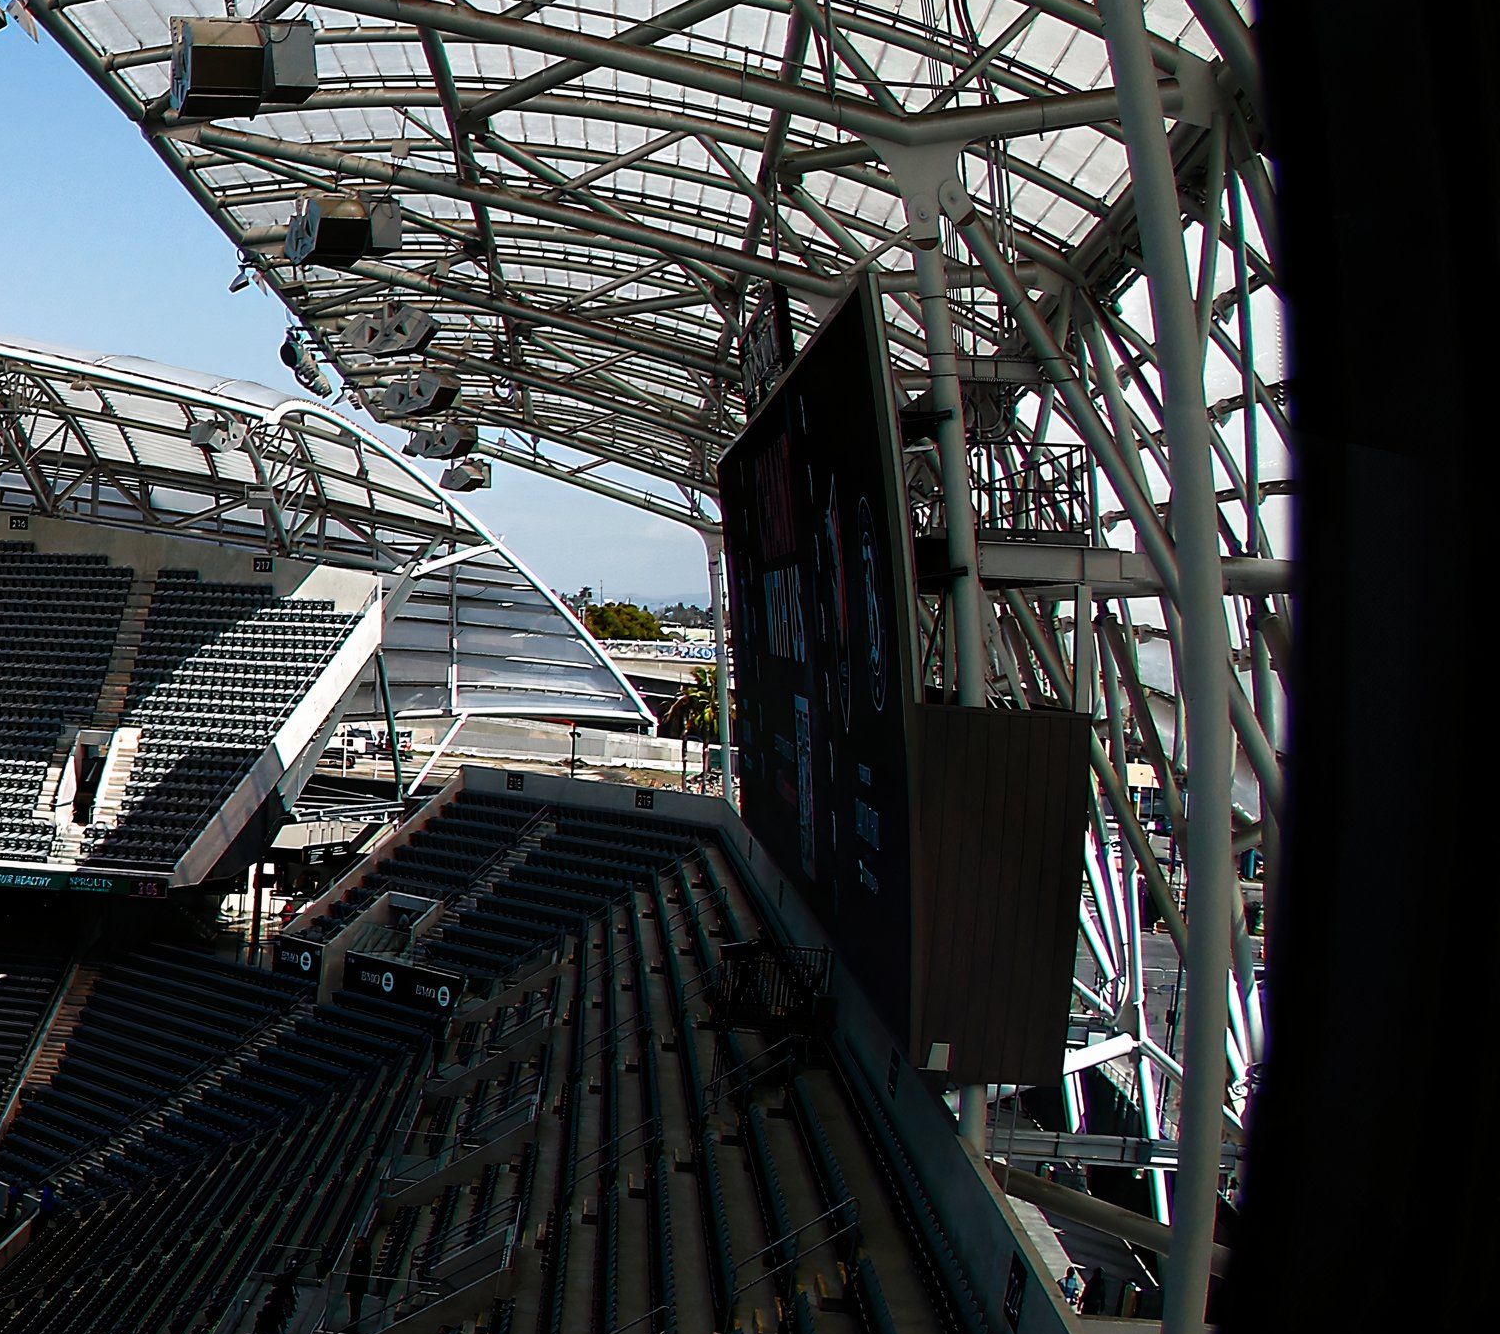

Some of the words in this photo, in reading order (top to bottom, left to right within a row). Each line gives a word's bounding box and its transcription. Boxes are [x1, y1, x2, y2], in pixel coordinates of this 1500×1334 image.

[255, 560, 270, 570] 217
[14, 873, 52, 887] HEALTHY
[68, 876, 113, 888] SPROUTS
